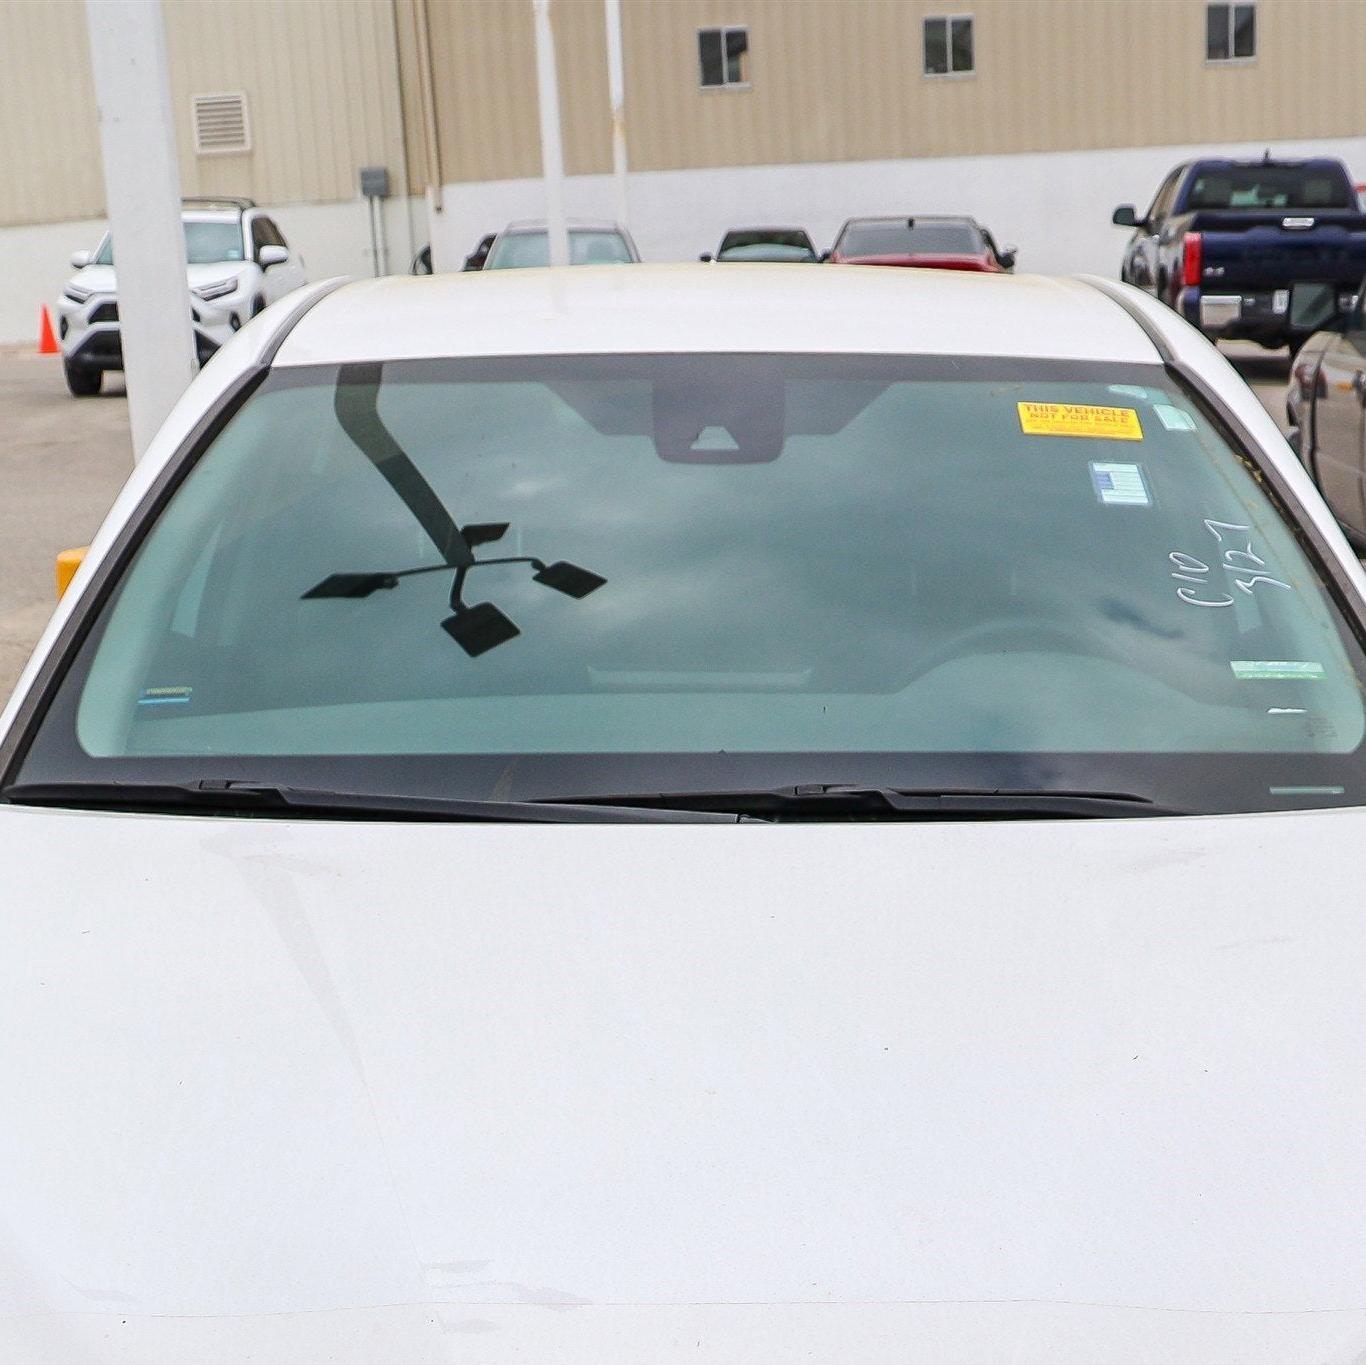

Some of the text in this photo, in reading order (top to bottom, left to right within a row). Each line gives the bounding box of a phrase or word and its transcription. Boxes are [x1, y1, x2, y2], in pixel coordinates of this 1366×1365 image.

[1026, 404, 1130, 417] THIS VEHICLE
[1030, 412, 1129, 424] NOT FOR SALE
[1168, 551, 1235, 608] C10
